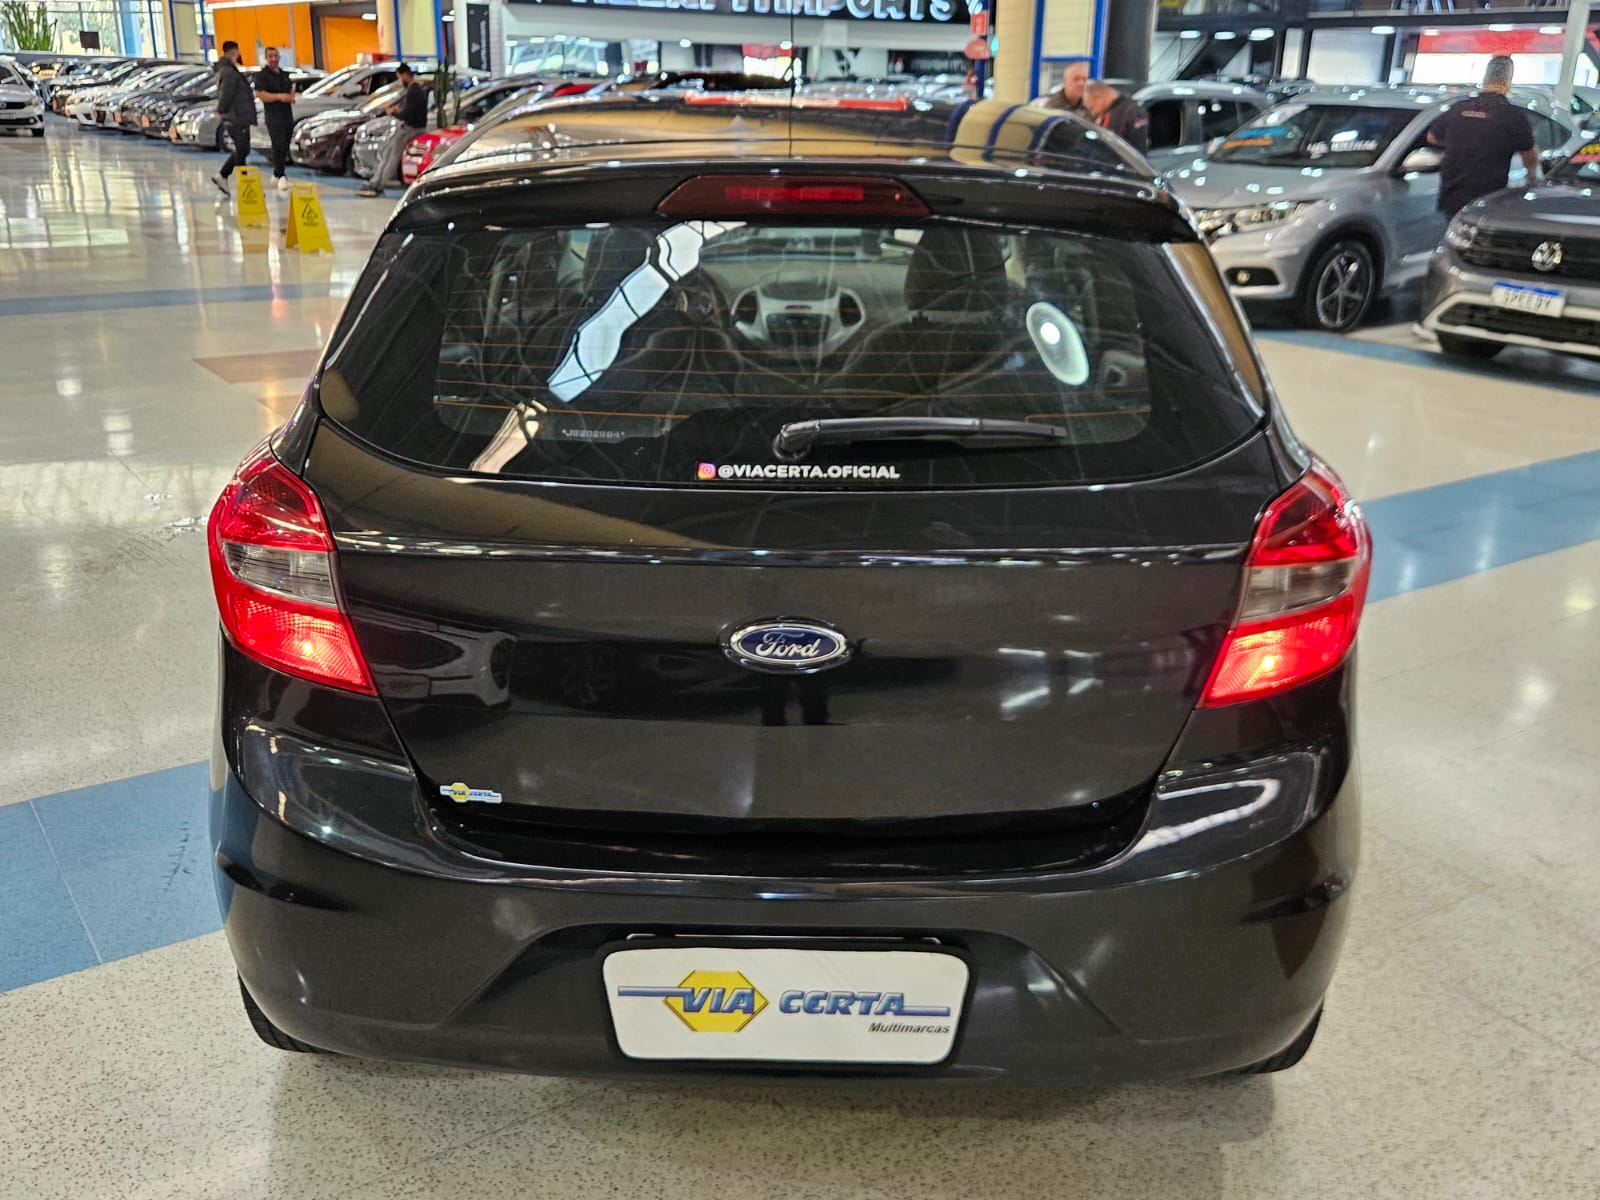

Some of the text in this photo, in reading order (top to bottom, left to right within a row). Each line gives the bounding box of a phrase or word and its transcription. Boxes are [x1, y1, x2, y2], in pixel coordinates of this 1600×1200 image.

[718, 464, 900, 479] @VIACERTA.OFICIAL
[755, 631, 821, 658] Ford
[682, 987, 755, 1014] VIA
[868, 1022, 951, 1034] Multimarcas
